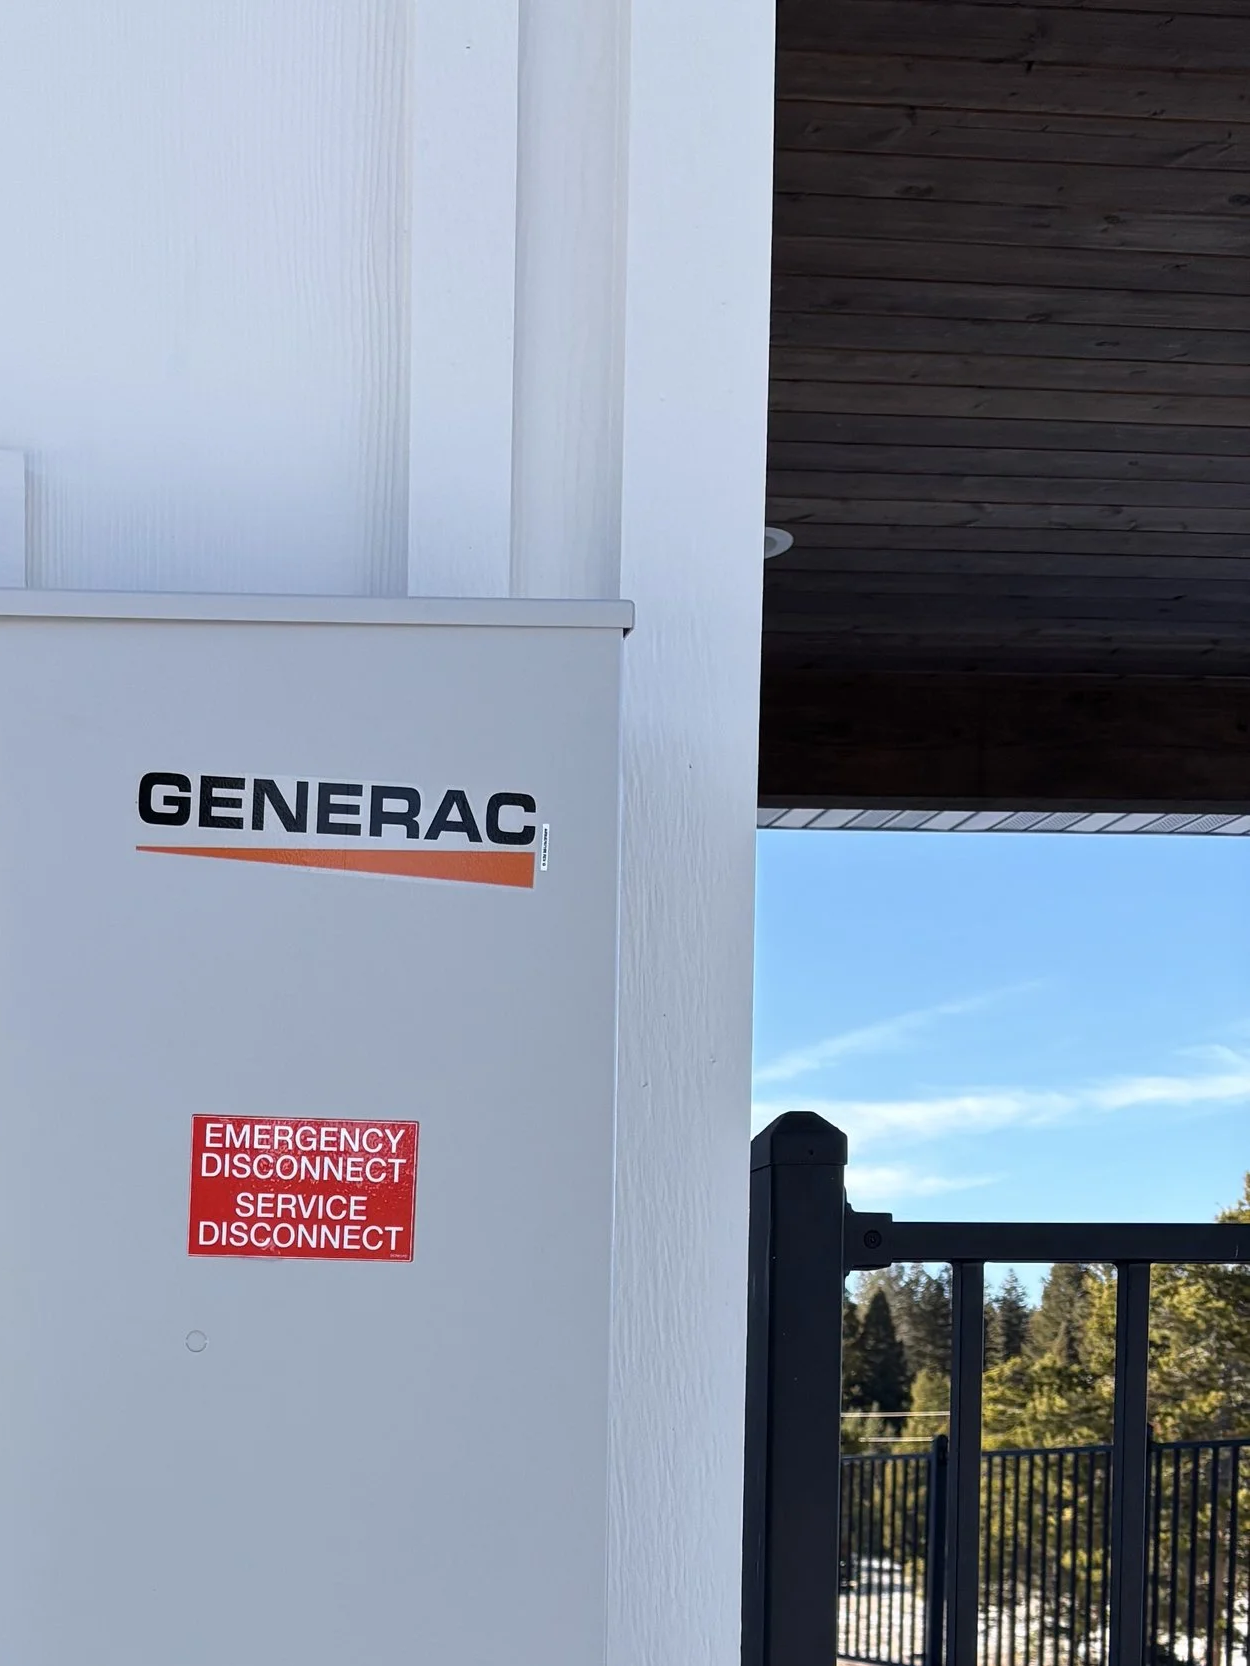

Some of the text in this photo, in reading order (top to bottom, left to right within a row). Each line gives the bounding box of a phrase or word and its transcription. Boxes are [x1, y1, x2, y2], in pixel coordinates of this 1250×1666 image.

[138, 771, 537, 846] GENERAC
[205, 1123, 405, 1154] EMERGENCY
[201, 1153, 407, 1183] DISCONNECT
[235, 1192, 368, 1221] SERVICE
[198, 1221, 404, 1251] DISCONNECT
